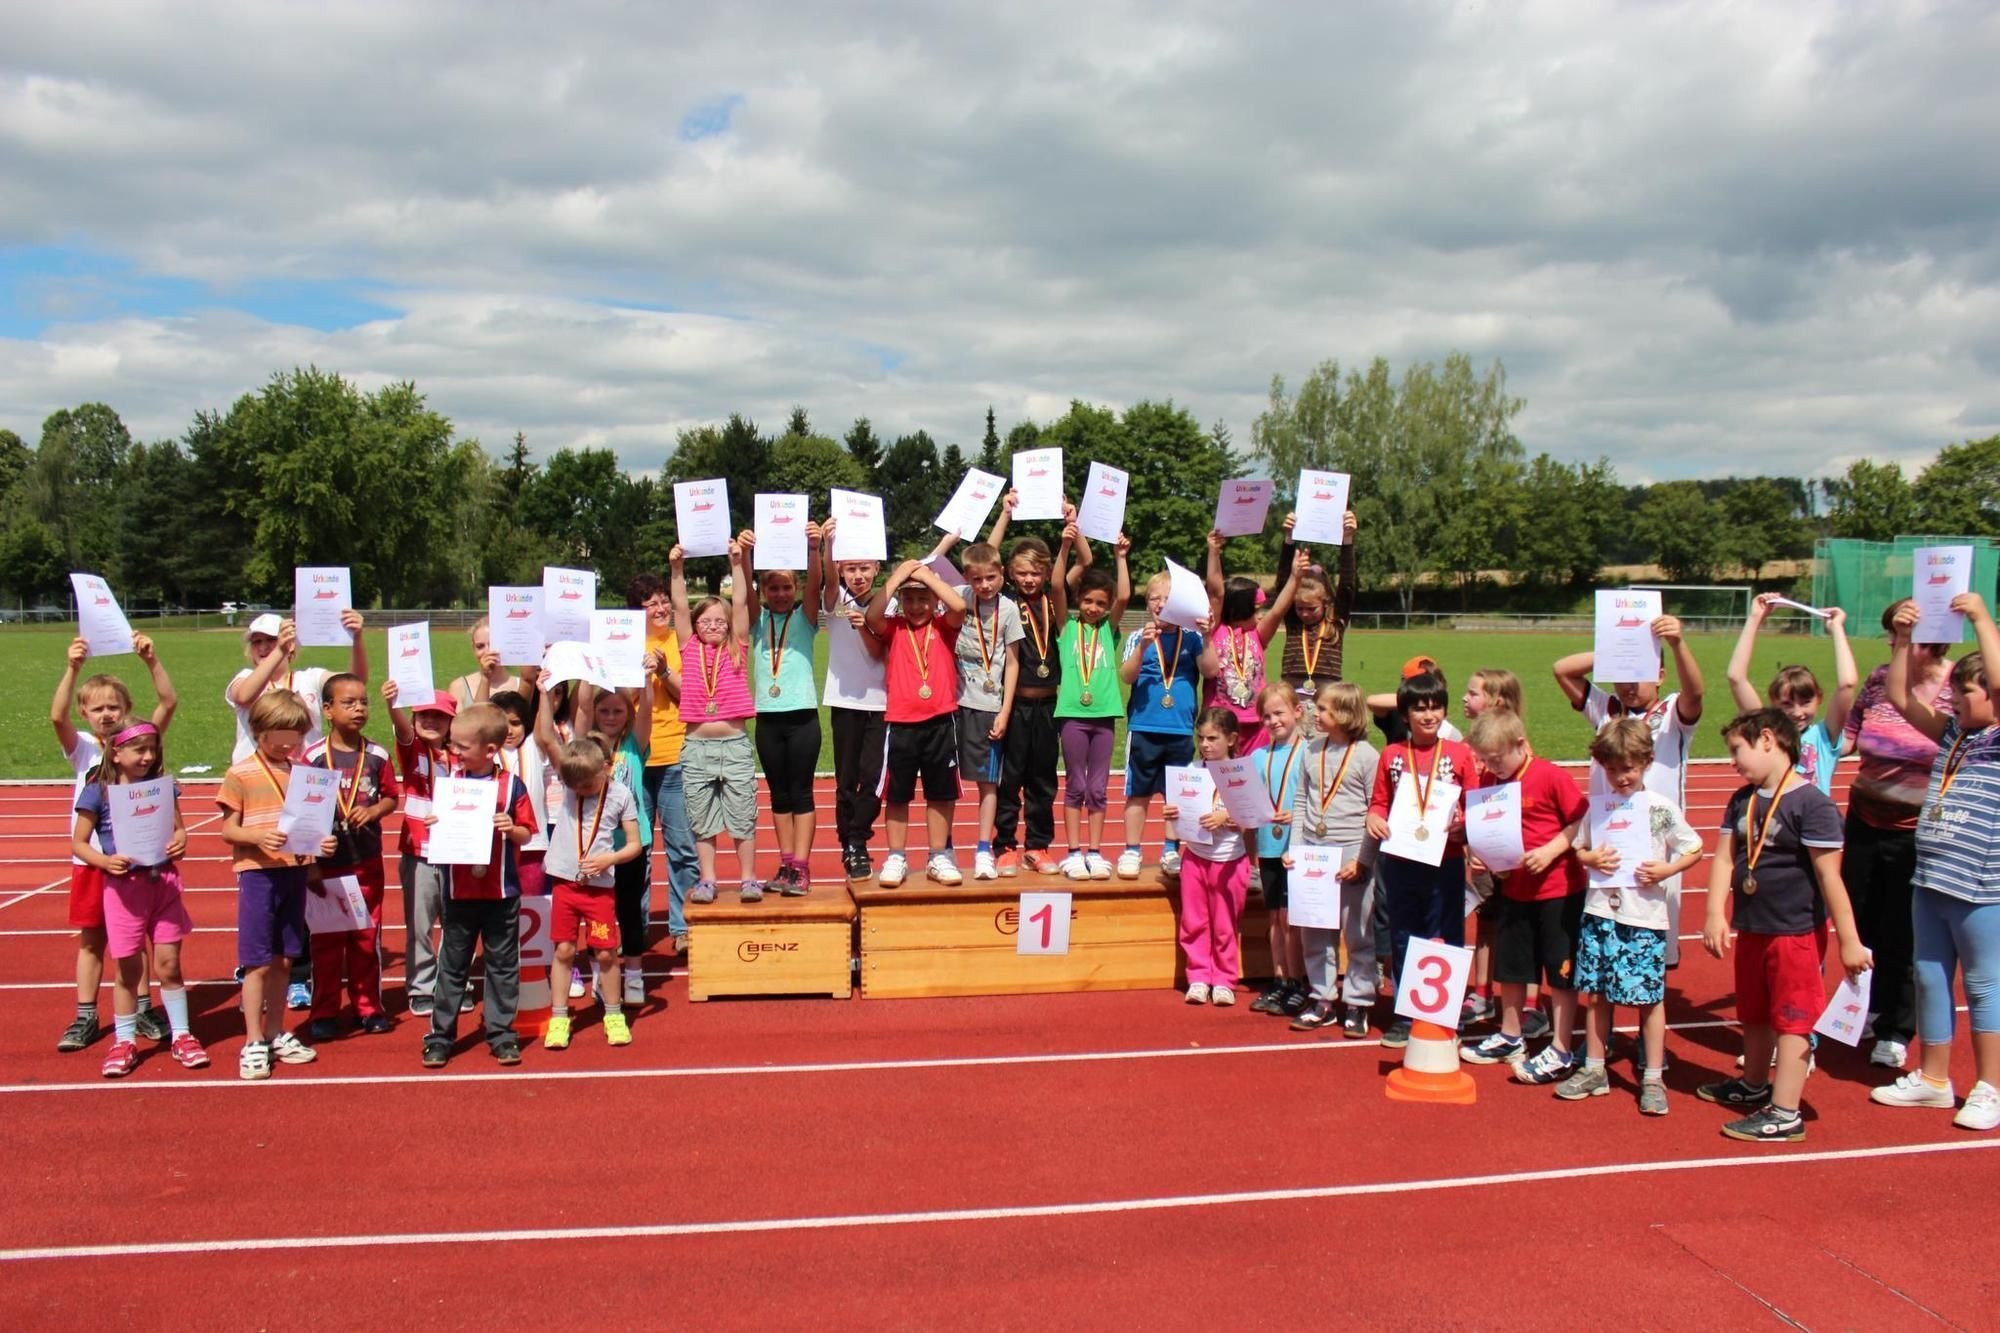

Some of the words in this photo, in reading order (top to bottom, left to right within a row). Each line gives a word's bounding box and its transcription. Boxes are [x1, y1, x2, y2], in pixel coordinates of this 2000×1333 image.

[519, 908, 543, 959] 2
[1029, 904, 1052, 949] 1
[1409, 955, 1452, 1014] 3
